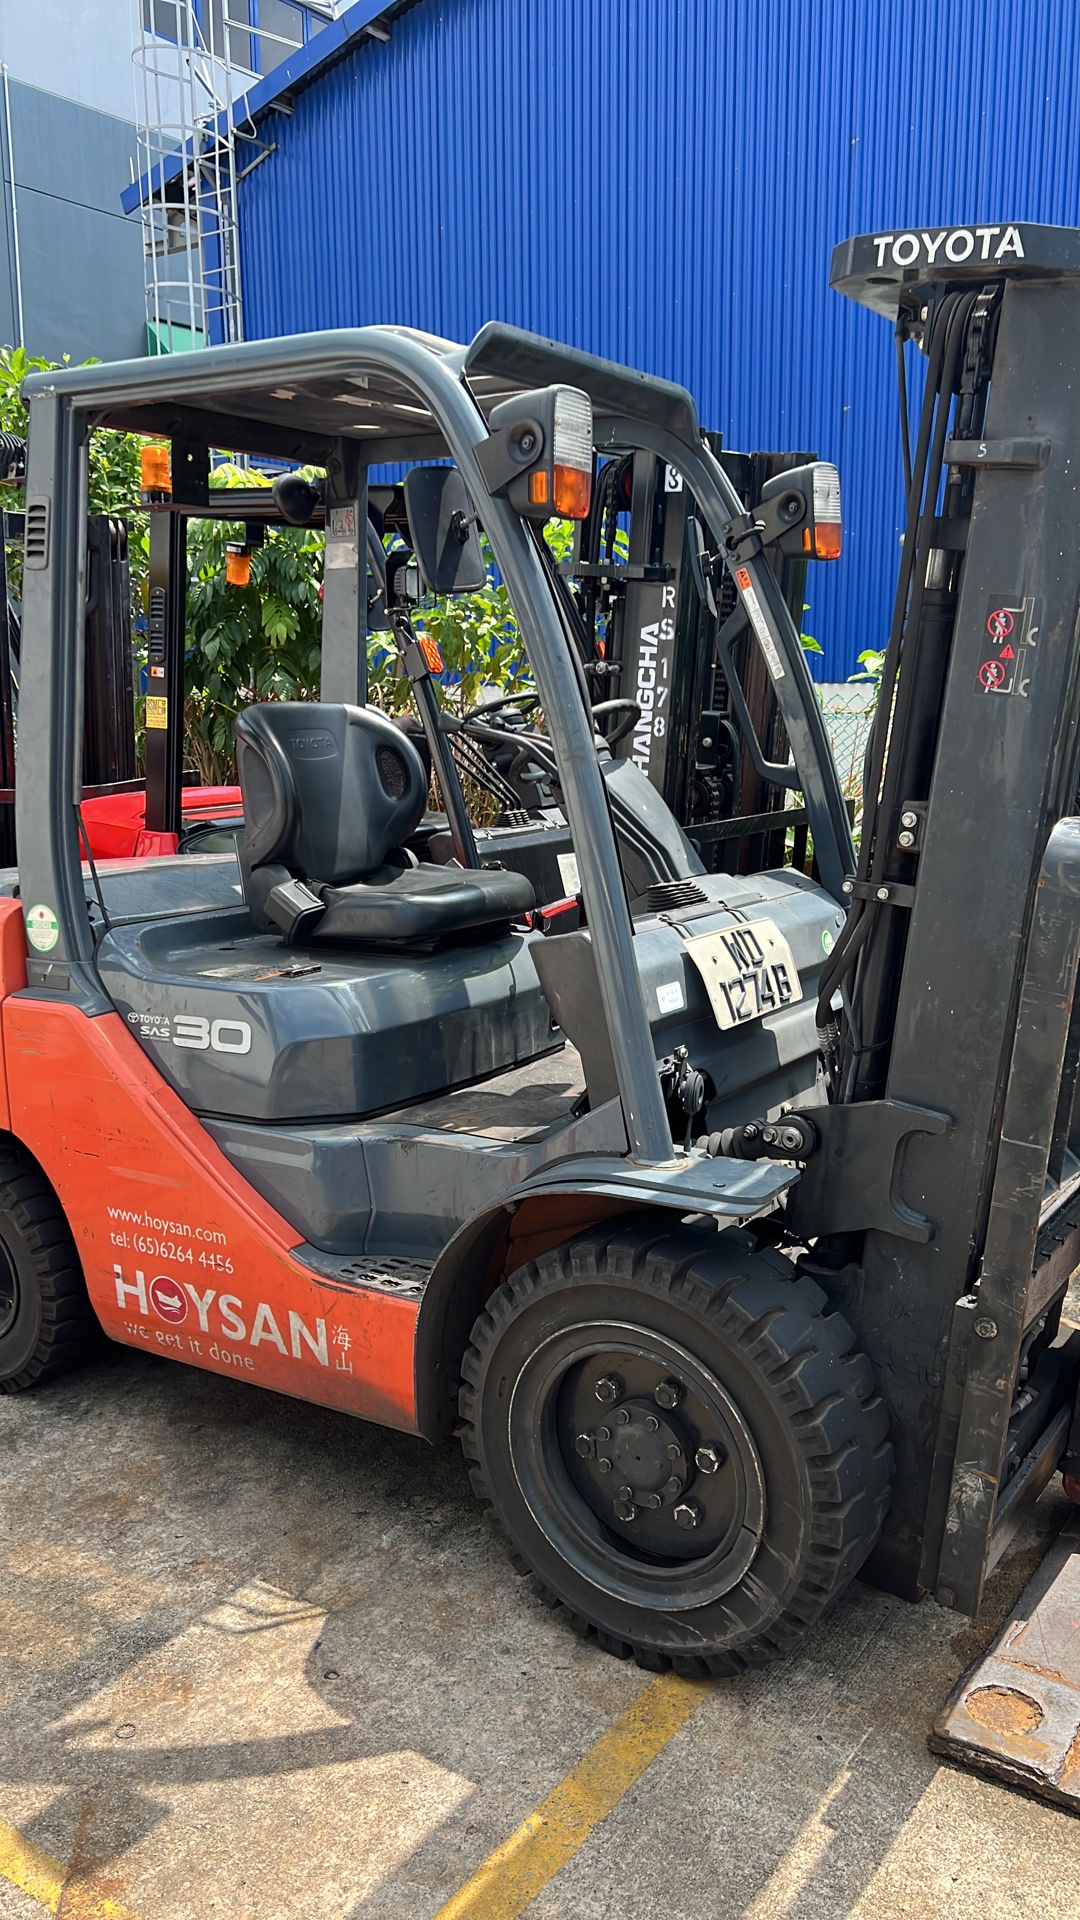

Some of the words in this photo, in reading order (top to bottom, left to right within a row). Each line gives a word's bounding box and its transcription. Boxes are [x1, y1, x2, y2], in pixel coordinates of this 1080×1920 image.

[873, 226, 1026, 268] TOYOTA
[631, 622, 660, 778] HANGCHA
[290, 736, 335, 750] TOYOTA
[139, 1014, 170, 1026] TOYOTA
[140, 1026, 170, 1037] SAS
[172, 1014, 252, 1055] 30
[106, 1206, 227, 1246] www.hoysan.com
[110, 1231, 131, 1249] tel:
[133, 1232, 194, 1265] (65)6264
[198, 1250, 234, 1275] 4456
[113, 1263, 330, 1368] HOYSAN
[124, 1321, 149, 1339] we
[155, 1330, 184, 1350] get
[188, 1336, 204, 1356] it
[209, 1342, 256, 1372] done
[331, 1324, 353, 1375] 海山
